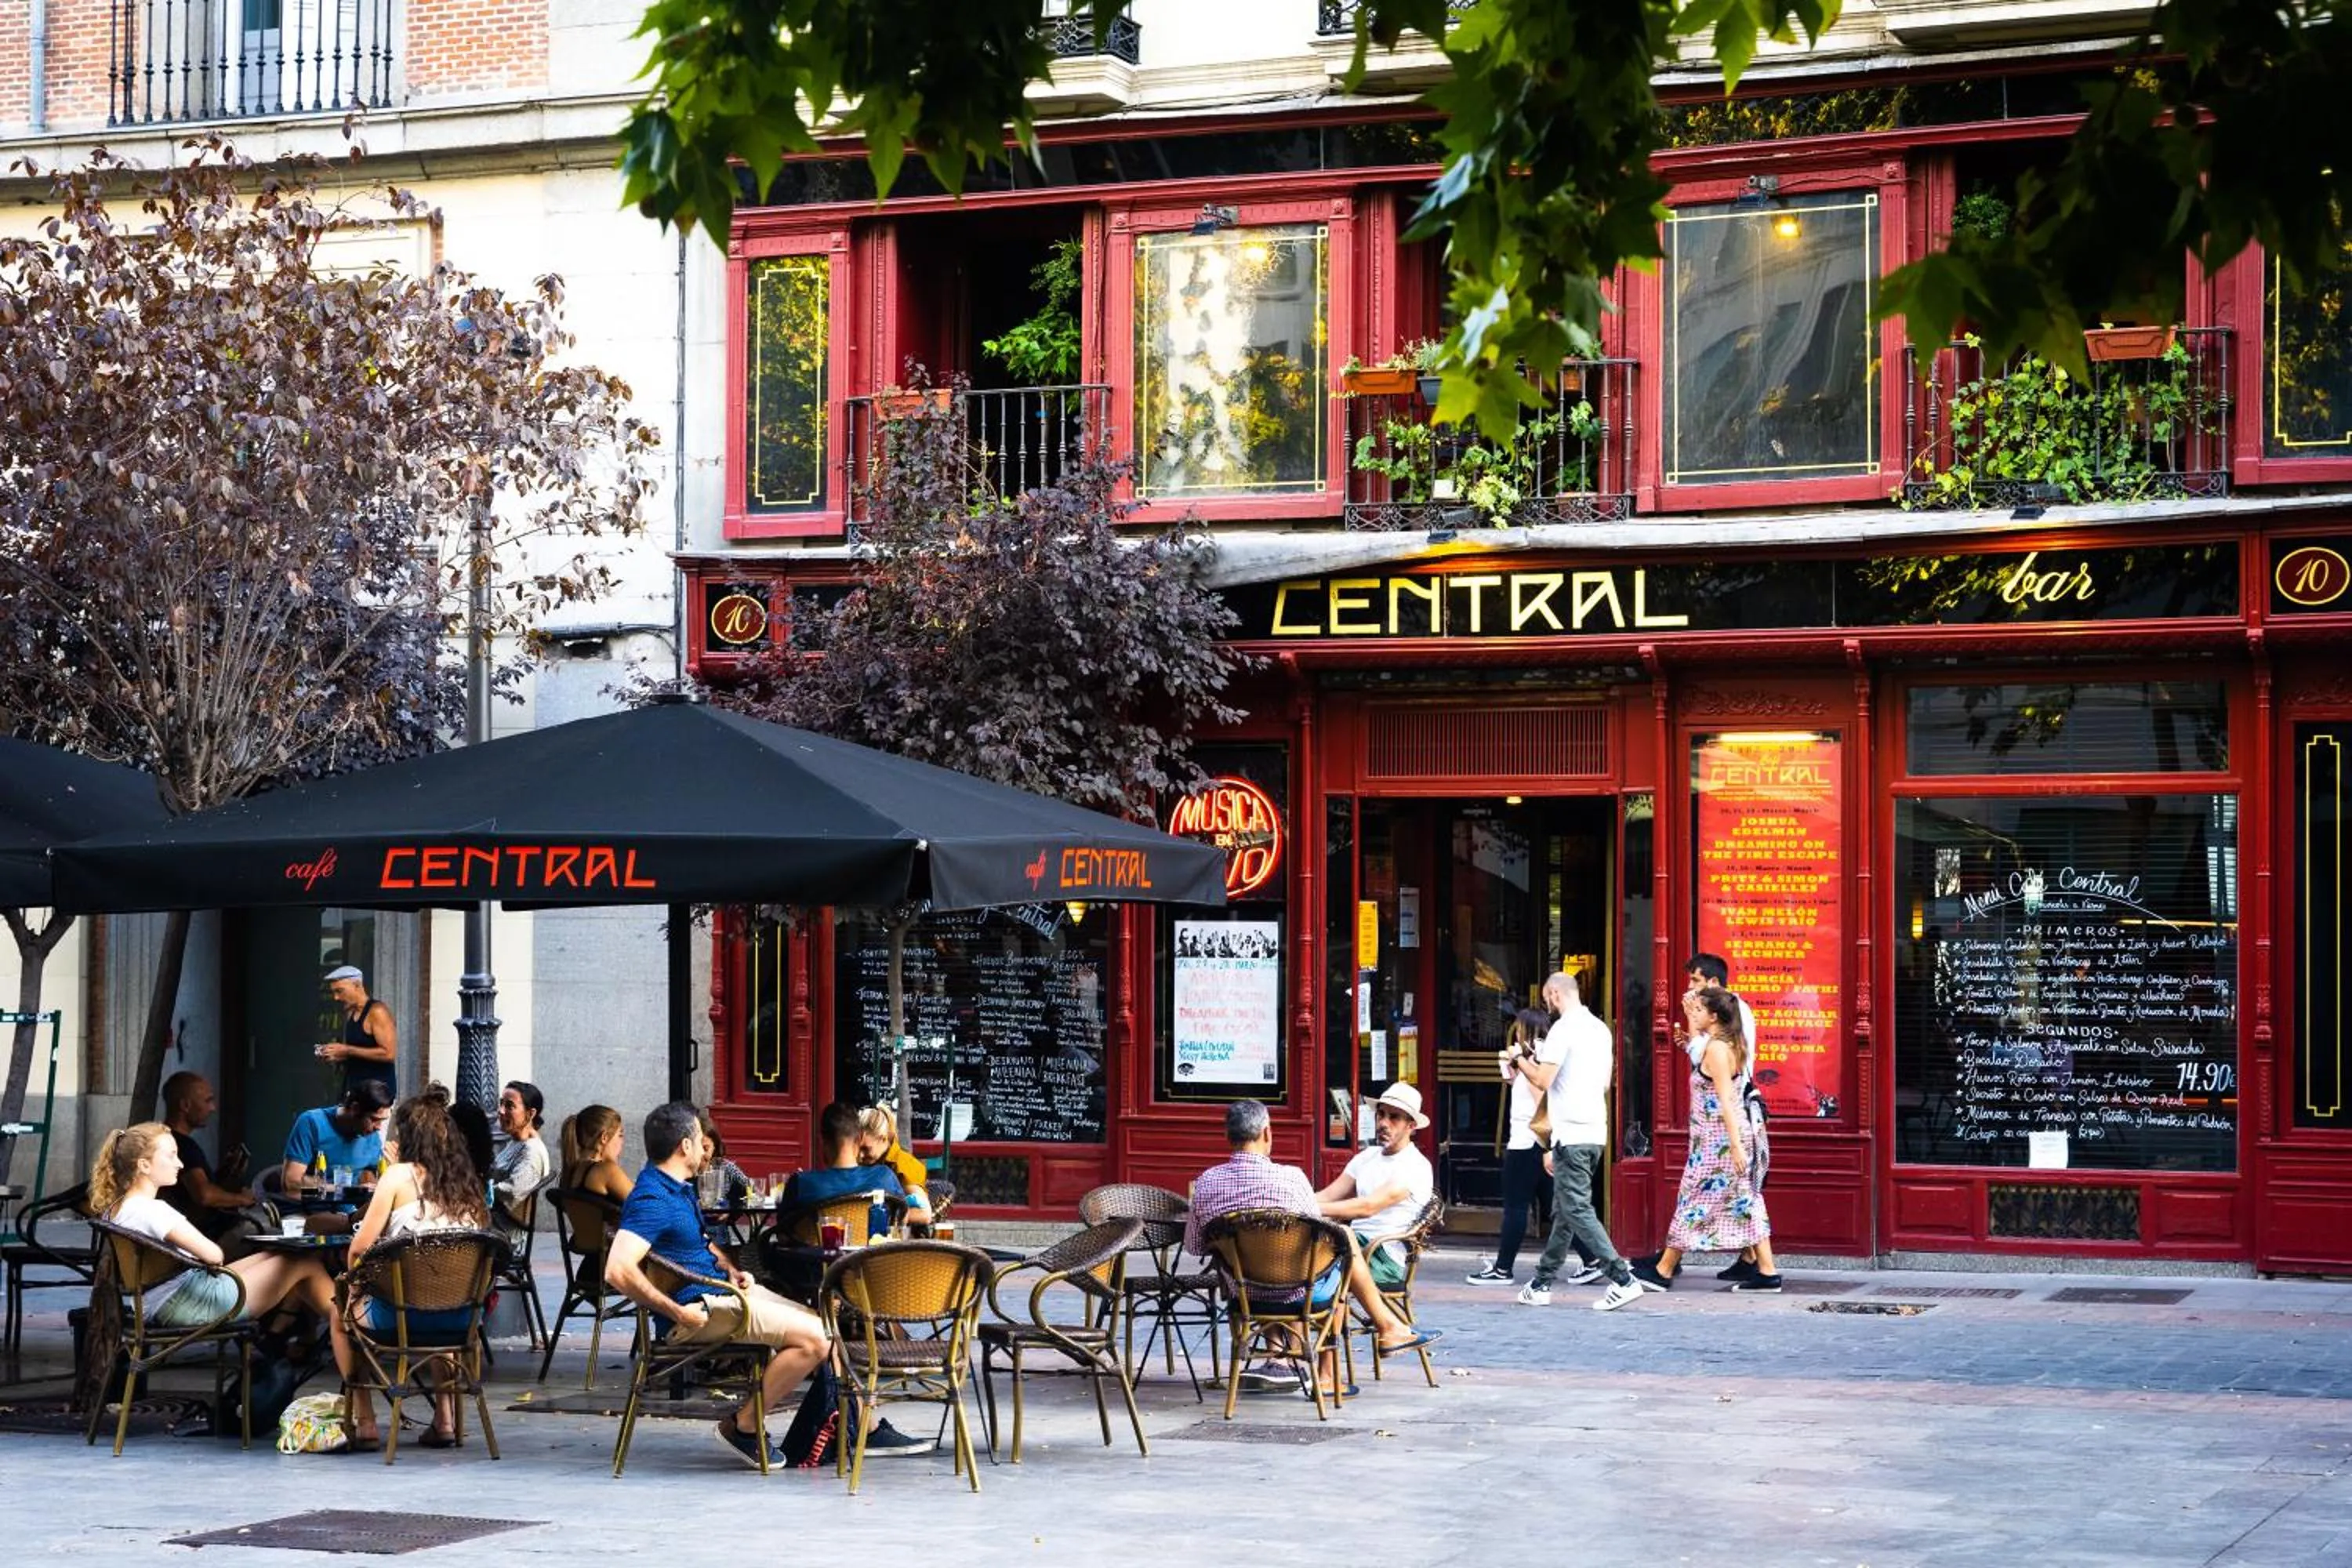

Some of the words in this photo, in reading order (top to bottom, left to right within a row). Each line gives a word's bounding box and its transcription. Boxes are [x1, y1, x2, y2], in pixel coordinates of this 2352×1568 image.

[2001, 551, 2096, 603] bar
[2293, 557, 2328, 593] 10
[1272, 569, 1689, 636] CENTRAL
[1709, 765, 1831, 785] CENTRAL
[1178, 788, 1270, 833] MUSICA
[1740, 817, 1799, 826] JOSHUA
[1731, 827, 1808, 837] EDELMAN
[1714, 840, 1798, 849] DREAMING
[1802, 840, 1826, 849] ON
[1703, 851, 1733, 860] THE
[1736, 851, 1773, 860] FIRE
[1777, 851, 1838, 860] ESCAPE
[285, 848, 338, 891] café
[380, 847, 656, 888] CENTRAL
[1059, 848, 1152, 888] CENTRAL
[1777, 875, 1829, 884] SIMON
[1964, 883, 2005, 922] Menú
[2059, 867, 2143, 904] Central
[1016, 902, 1065, 940] entral
[1726, 916, 1775, 926] LEWIS
[1726, 941, 1798, 949] SERRANO
[2025, 1022, 2114, 1039] SEGUNDOS
[1759, 1044, 1826, 1054] COLOMA
[1964, 1048, 2011, 1068] Bacalao
[2014, 1051, 2066, 1068] Dorado
[1964, 1067, 2005, 1086] Huevos
[2018, 1110, 2030, 1120] de
